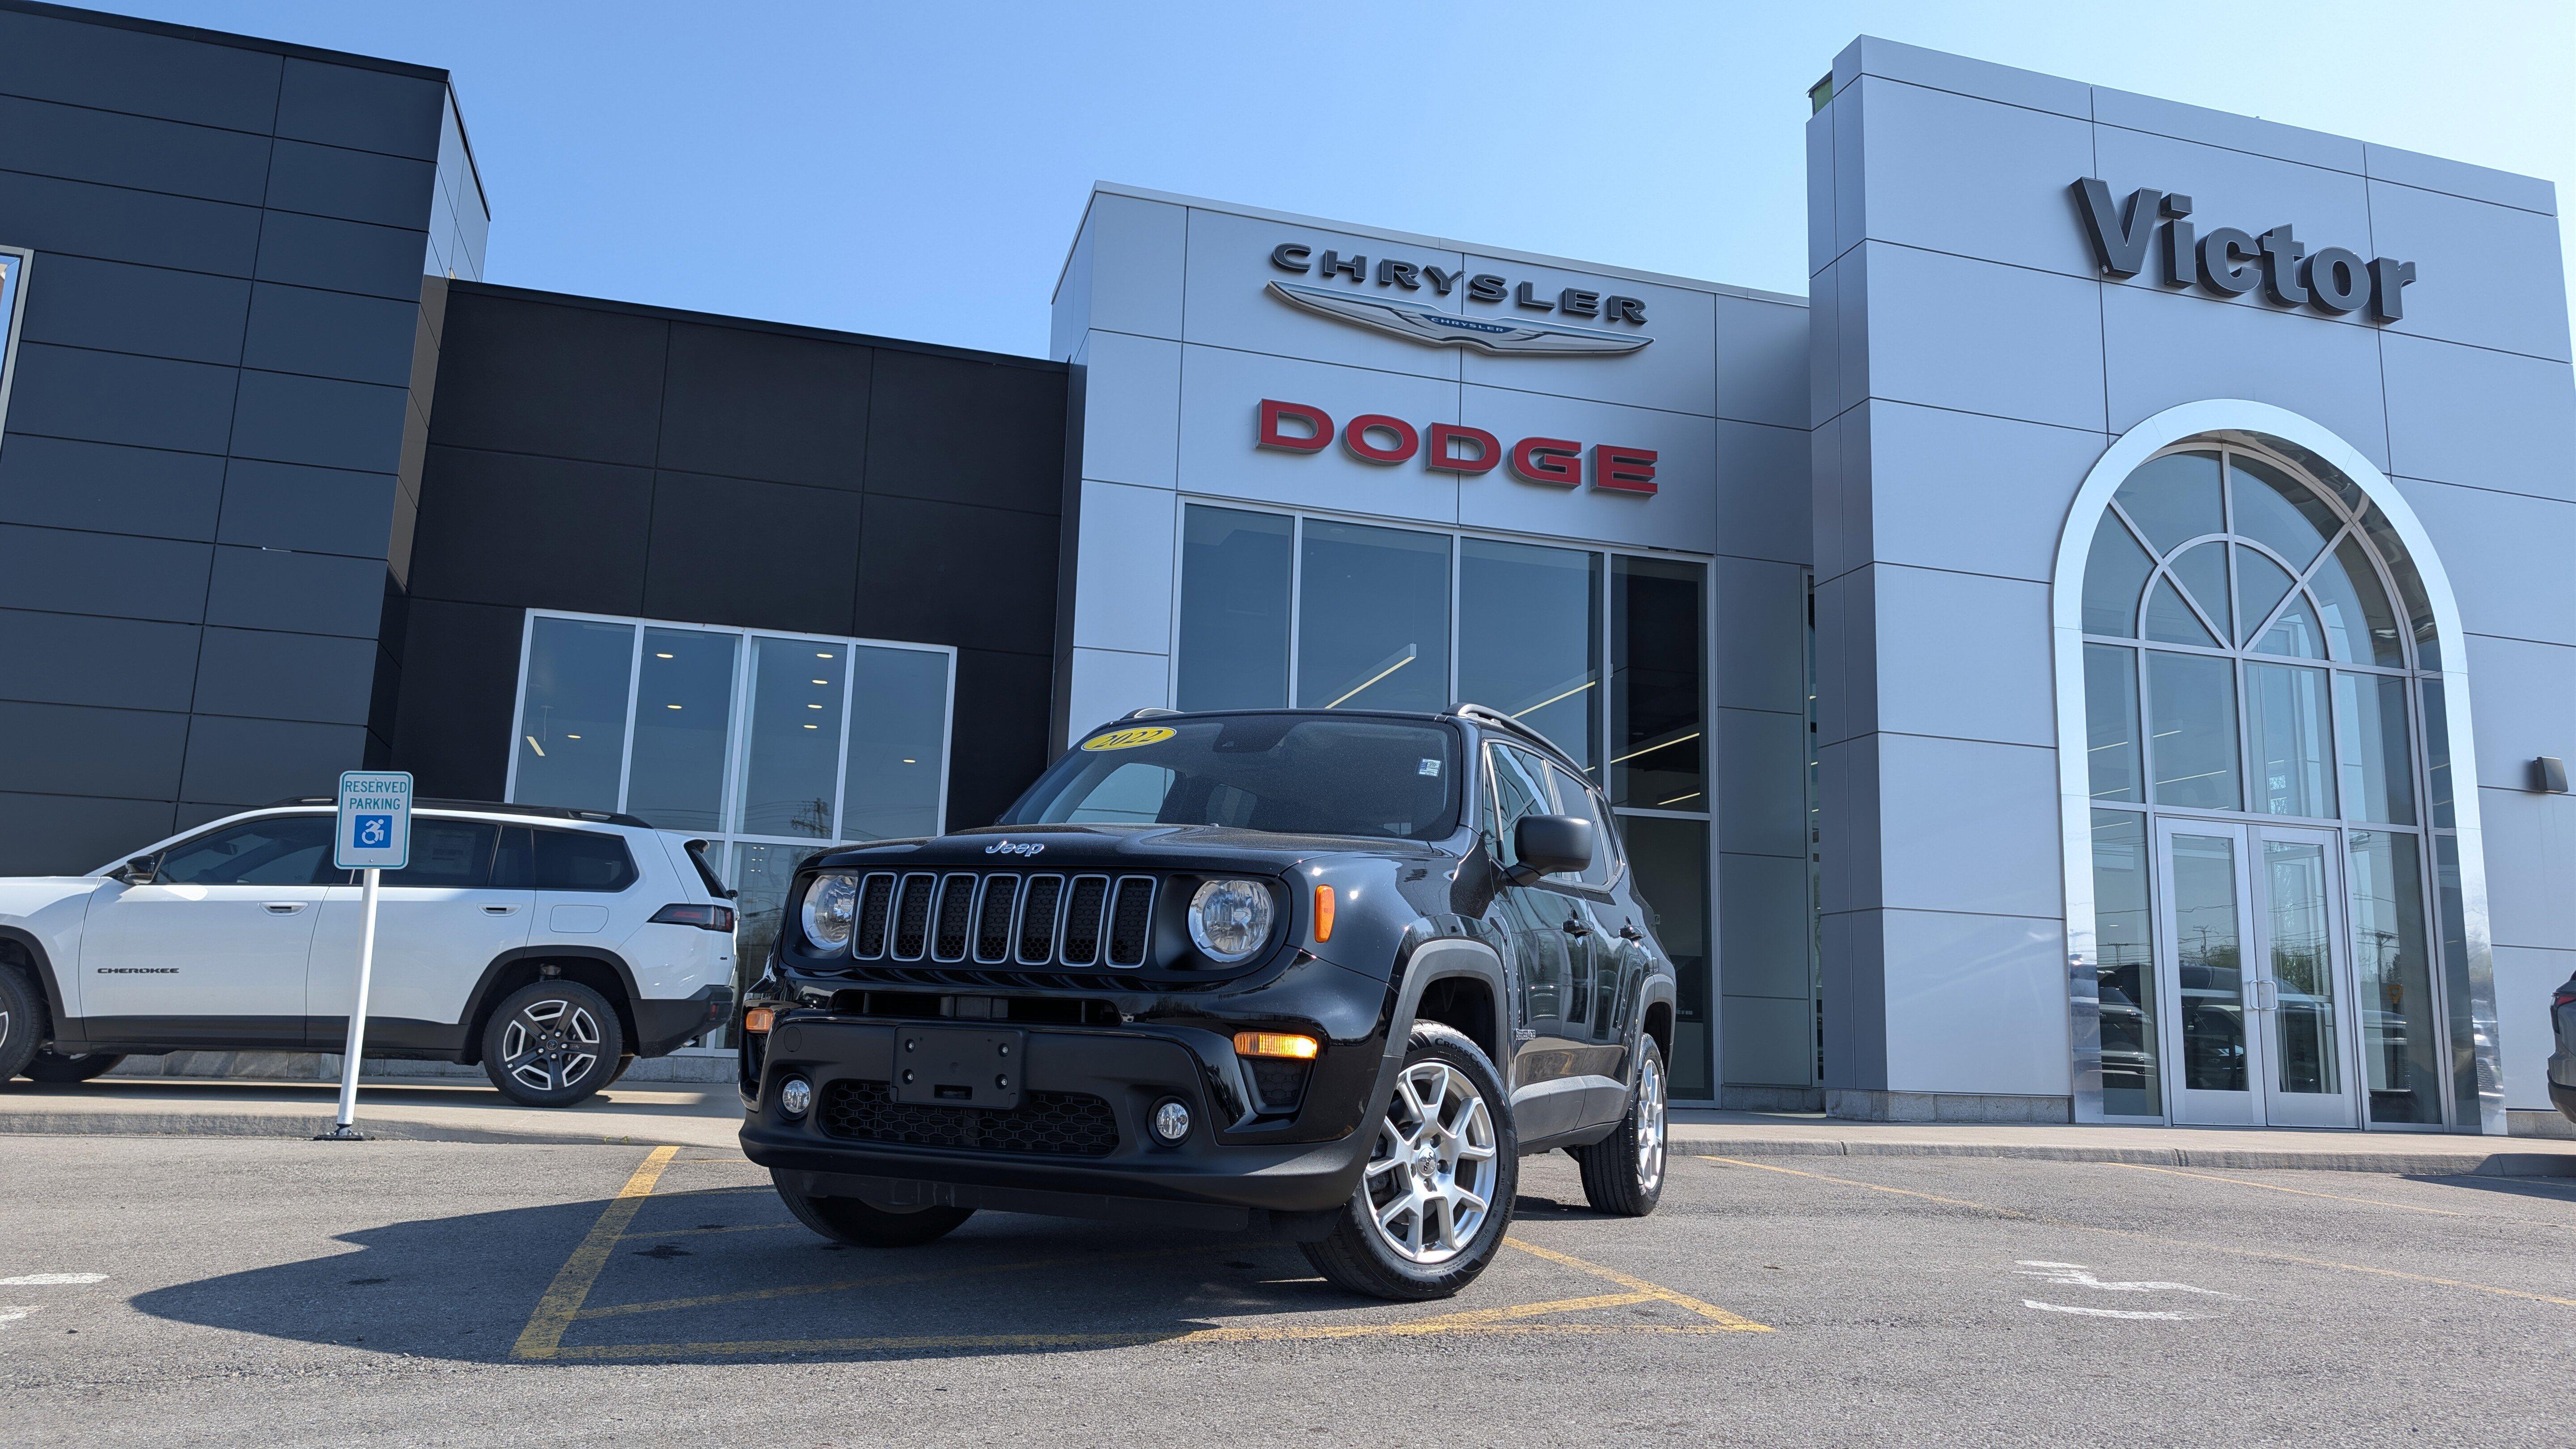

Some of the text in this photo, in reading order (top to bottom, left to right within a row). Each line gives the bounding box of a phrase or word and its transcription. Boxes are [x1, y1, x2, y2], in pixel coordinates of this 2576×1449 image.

[2070, 177, 2416, 324] Victor
[1271, 243, 1647, 325] CHRYSLER
[1431, 317, 1504, 332] CHRYSLER
[1256, 398, 1658, 498] DODGE
[1092, 730, 1164, 749] 2022
[345, 781, 407, 793] RESERVED
[349, 798, 400, 810] PARKING
[985, 841, 1044, 857] Jeep
[1424, 1152, 1433, 1171] Jeep
